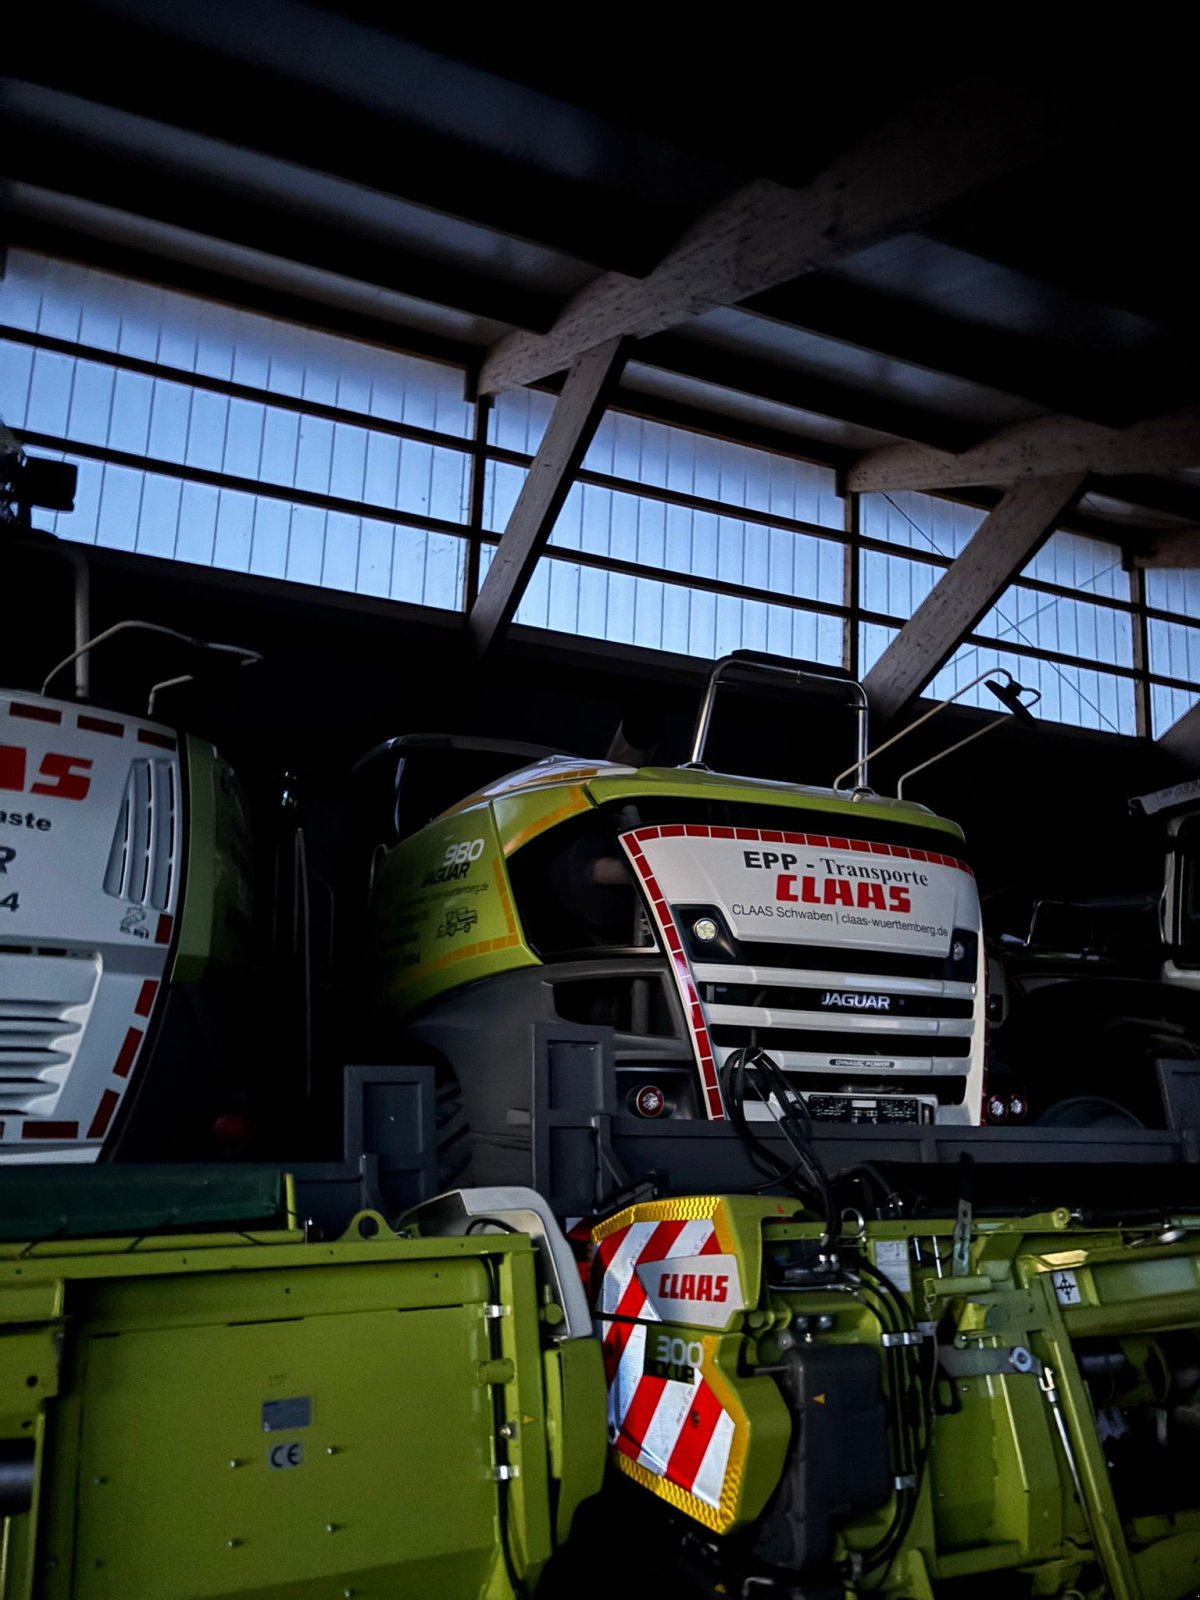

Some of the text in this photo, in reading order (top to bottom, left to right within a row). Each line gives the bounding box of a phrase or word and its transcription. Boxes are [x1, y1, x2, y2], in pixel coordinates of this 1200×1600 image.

[0, 745, 92, 801] S
[443, 838, 485, 867] 980
[743, 850, 797, 871] EPP
[820, 857, 928, 887] Transporte
[776, 873, 911, 914] CLAAS
[731, 903, 774, 918] CLAAS
[776, 906, 834, 923] Schwaben
[841, 914, 949, 937] claas-wuerttemberg.de
[821, 991, 891, 1011] JAGUAR
[658, 1273, 729, 1303] CLAAS
[655, 1334, 705, 1370] 300
